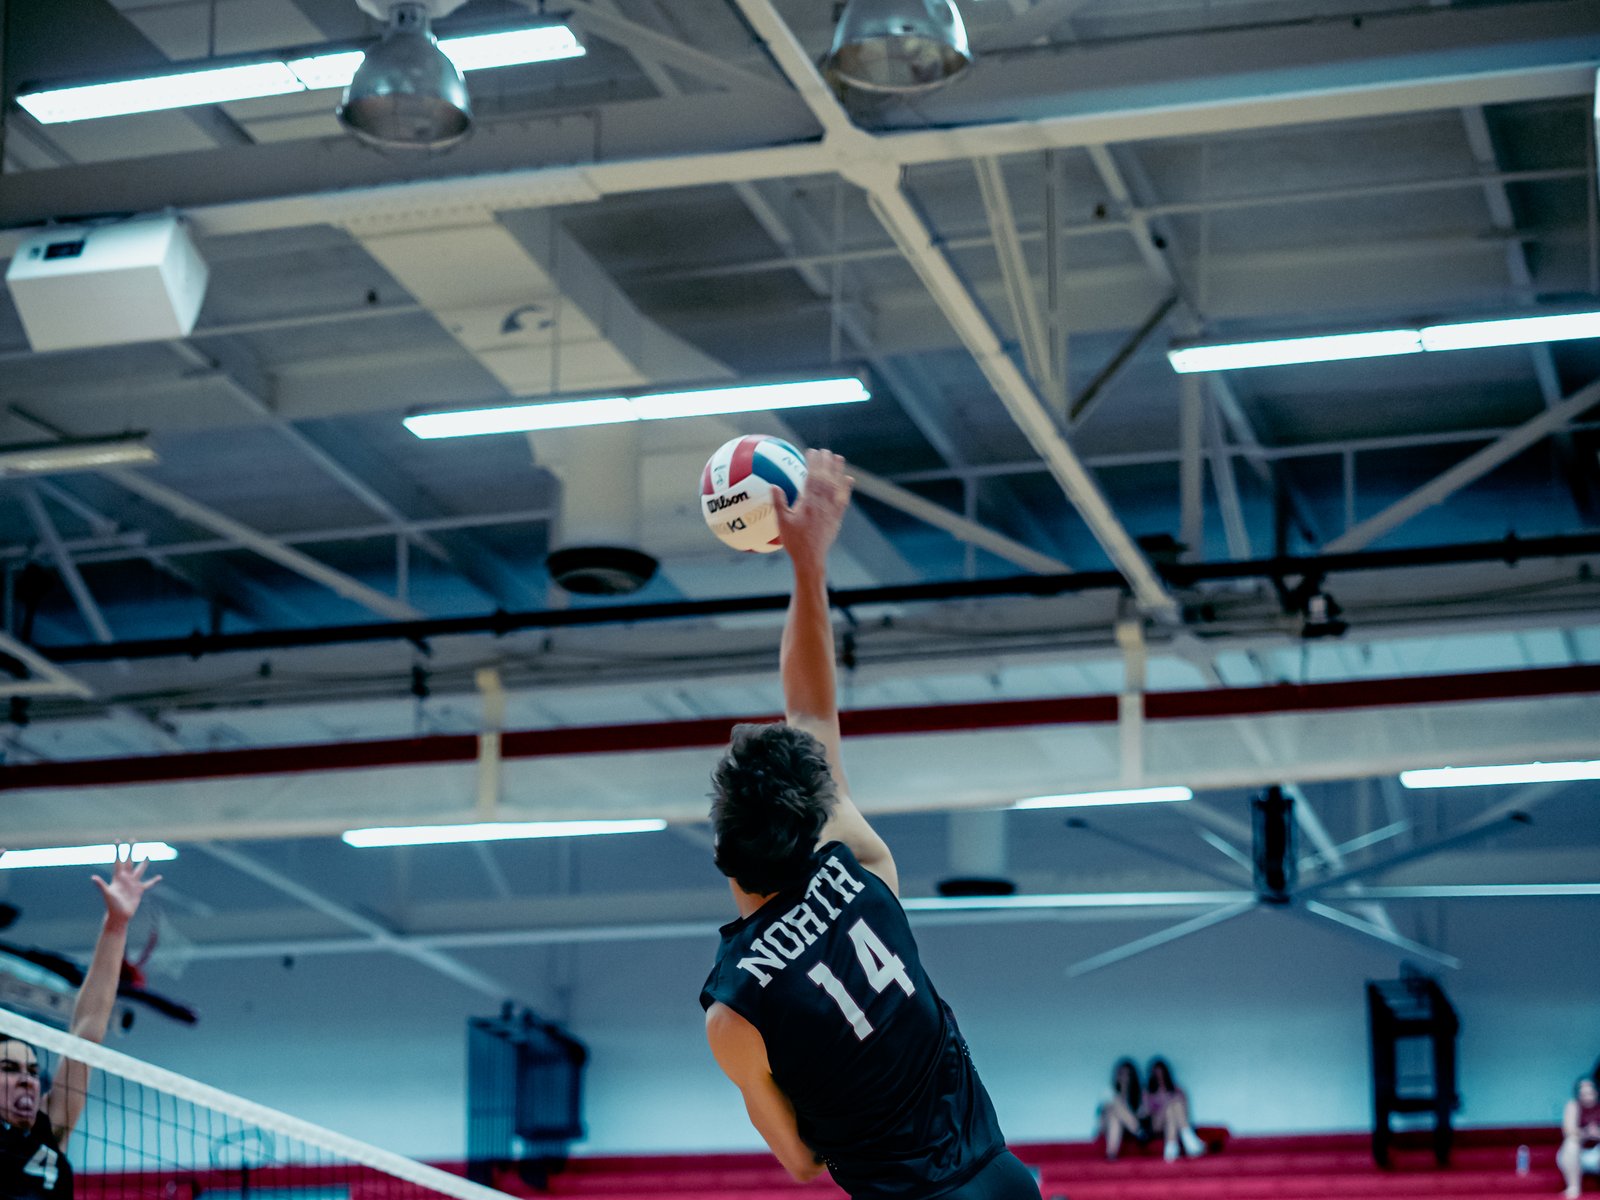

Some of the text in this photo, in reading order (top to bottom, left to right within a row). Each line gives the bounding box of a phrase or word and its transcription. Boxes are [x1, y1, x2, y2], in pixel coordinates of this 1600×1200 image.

[707, 490, 750, 514] Wilson
[736, 855, 866, 988] NORTH
[807, 917, 916, 1041] 14
[23, 1144, 59, 1190] 4
